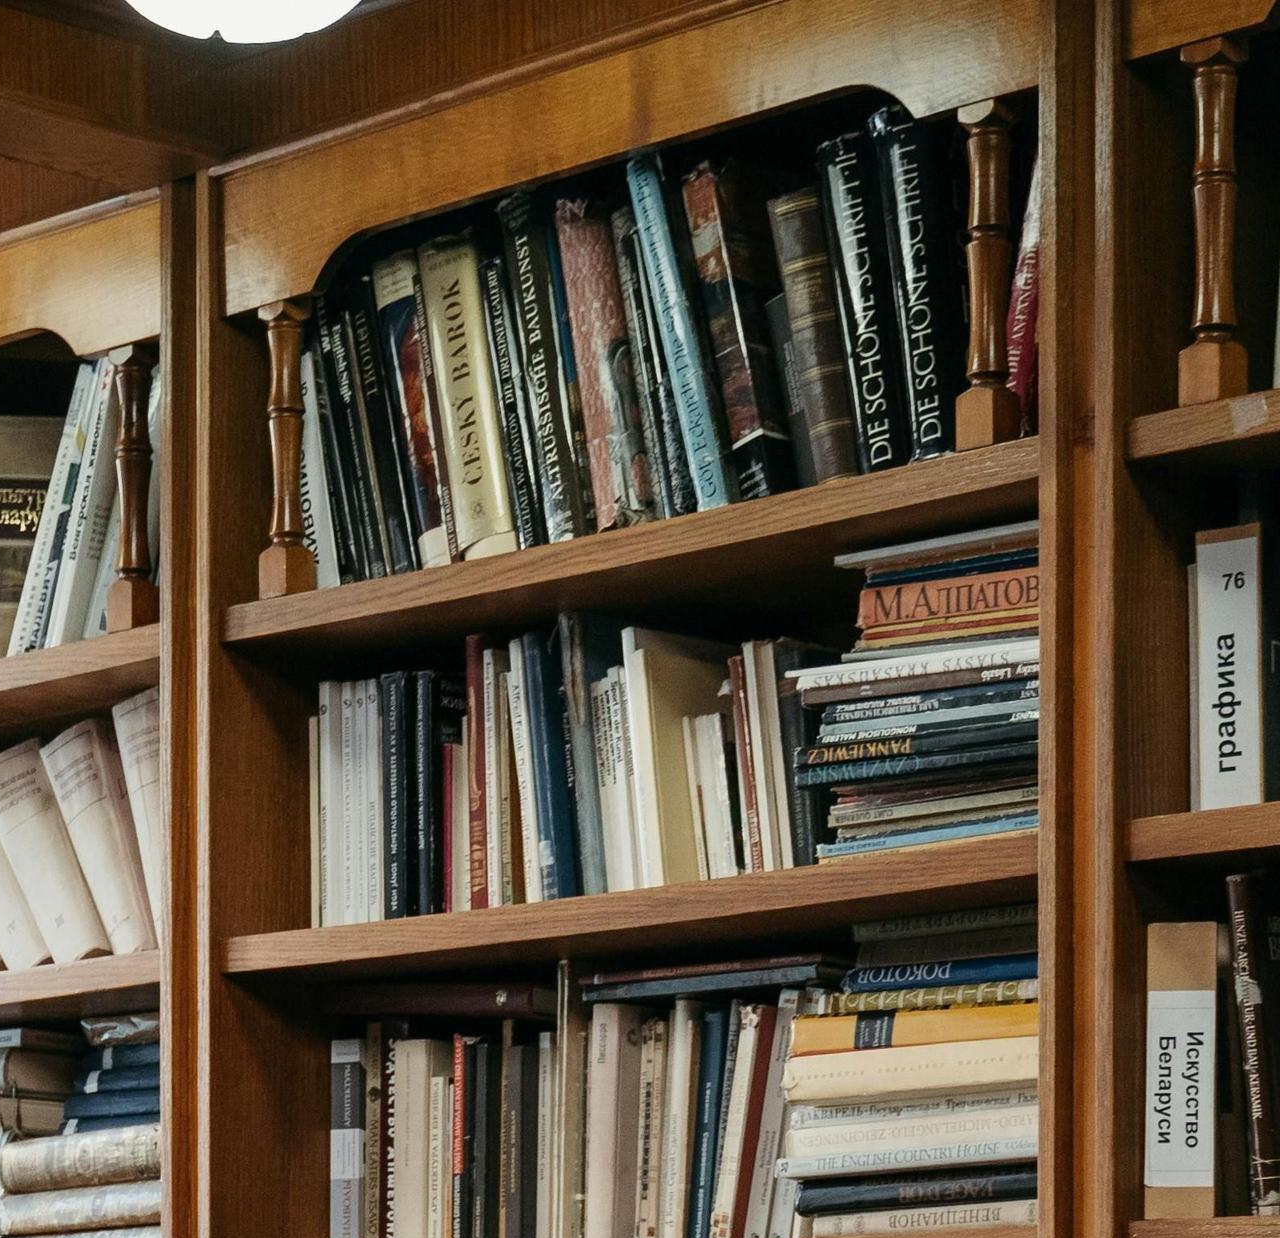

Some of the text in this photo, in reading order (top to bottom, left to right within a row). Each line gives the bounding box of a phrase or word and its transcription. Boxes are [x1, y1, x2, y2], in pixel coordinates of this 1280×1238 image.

[837, 179, 894, 466] DIE SCHÖNE SCHRIFT
[893, 143, 943, 444] DIE SCHÖNE SCHRIFT
[439, 276, 483, 487] ČESKÝ BAROK
[485, 266, 535, 546] MICHAEL DIE DRESDNER GALERIE
[514, 233, 565, 500] ALTRUSSISCHE BAUKUNST
[1222, 570, 1246, 592] 76
[807, 738, 911, 765] PANKIEWICZ
[1212, 632, 1242, 773] графика
[857, 961, 953, 984] РОКОТОВ
[1154, 1035, 1177, 1145] Беларуси
[1183, 1031, 1205, 1149] Искусство
[815, 1143, 1001, 1171] THE ENGLISH COUNTRY HOUSE
[887, 1206, 1002, 1229] ВЕНЕЦИАНОВ
